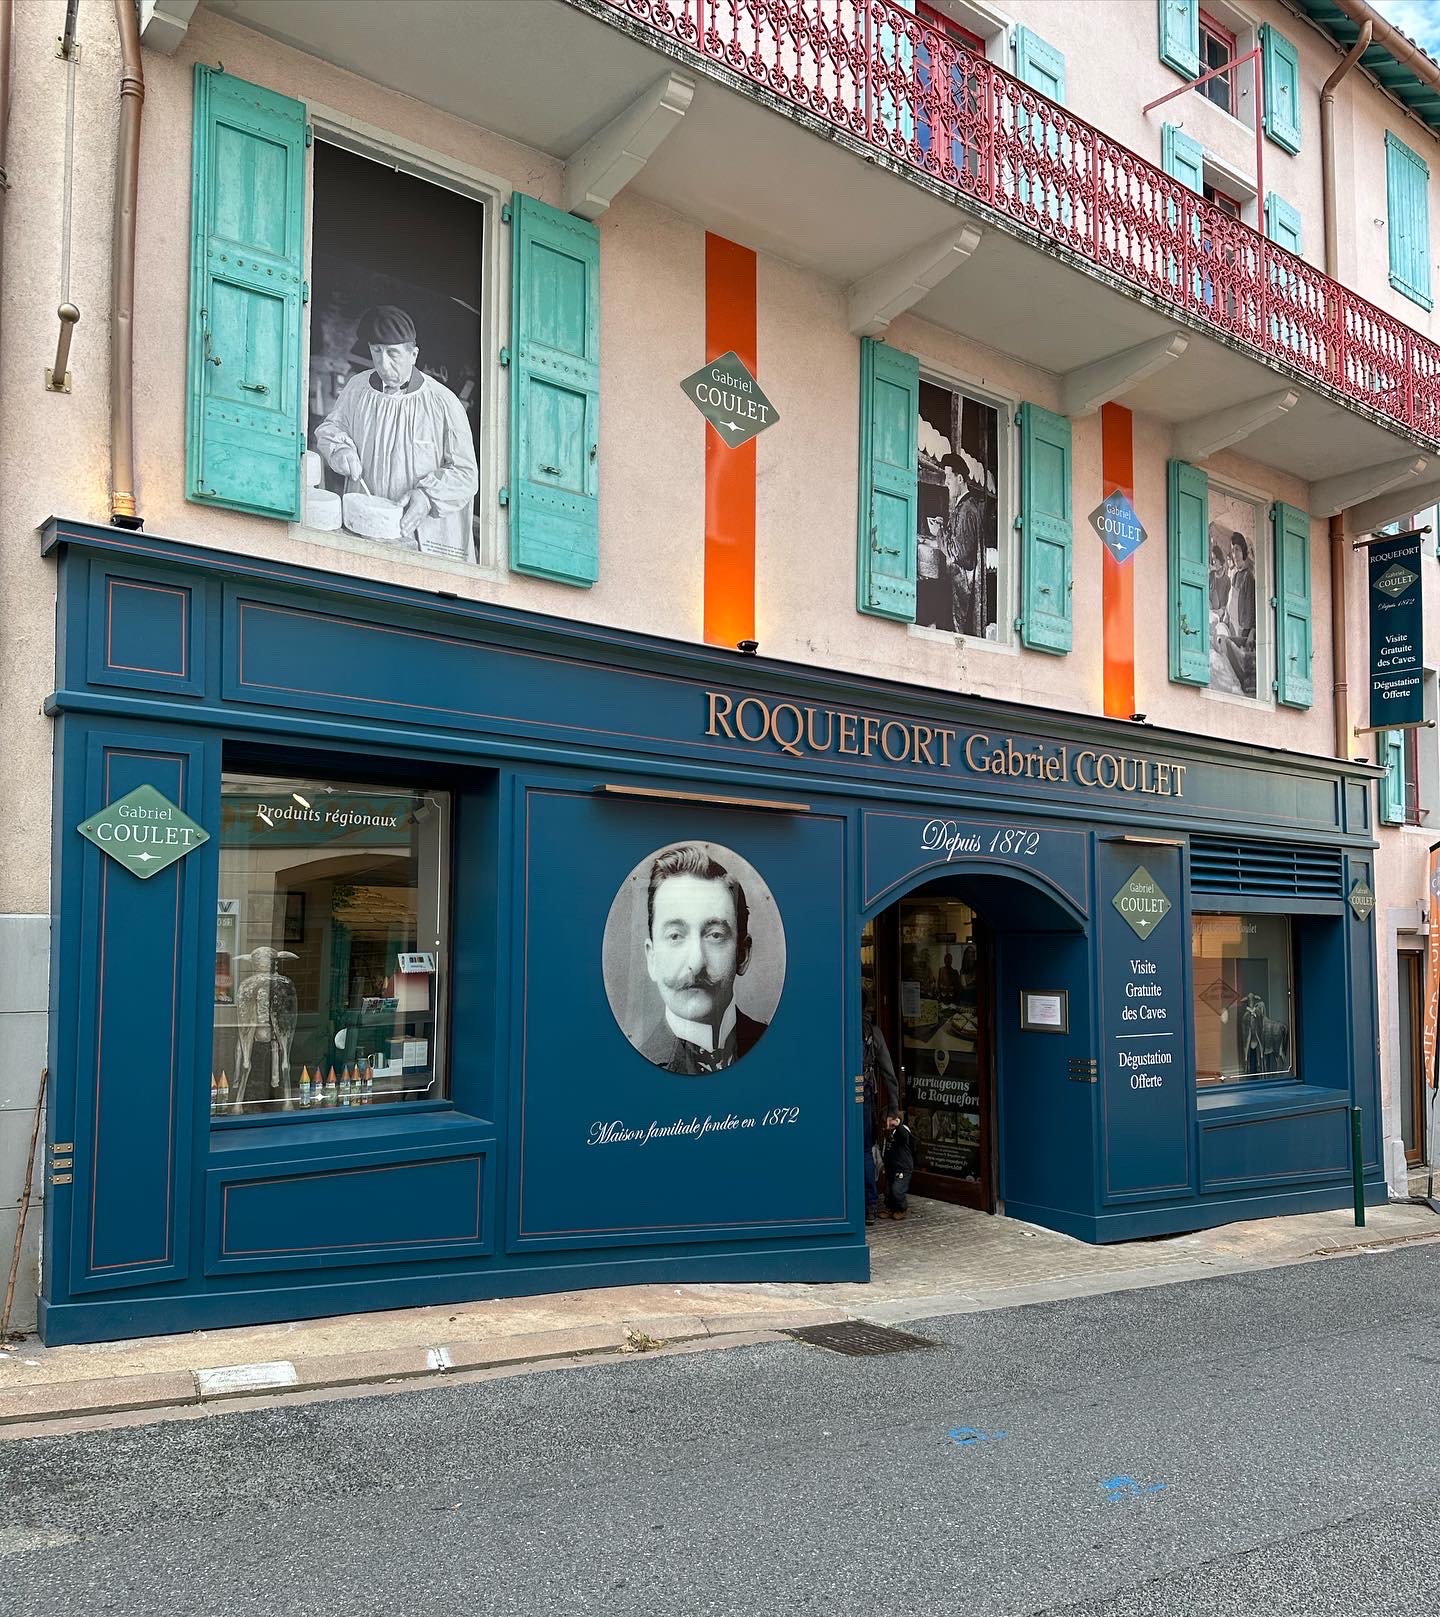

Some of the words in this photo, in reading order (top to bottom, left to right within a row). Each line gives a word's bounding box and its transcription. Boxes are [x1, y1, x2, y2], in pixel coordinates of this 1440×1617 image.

[711, 368, 753, 393] Gabriel
[696, 383, 769, 423] COULET
[1106, 503, 1131, 520] Gabriel
[1097, 516, 1141, 542] COULET
[1370, 546, 1419, 563] ROQUEFORT
[1379, 575, 1413, 588] COULET
[1385, 634, 1408, 643] Visite
[1381, 644, 1412, 655] Gratuite
[1377, 659, 1390, 667] des
[1392, 656, 1416, 665] Caves
[1374, 677, 1420, 690] Dégustation
[1382, 690, 1411, 699] Offerte
[704, 691, 956, 767] ROQUEFORT
[965, 734, 1069, 782] Gabriel
[1076, 751, 1187, 797] COULET
[118, 805, 172, 820] Gabriel
[257, 803, 321, 822] Produits
[325, 807, 397, 827] régionaux
[97, 823, 194, 845] COULET
[921, 819, 981, 861] Depuis
[989, 829, 1040, 855] 1872
[1130, 882, 1154, 893] Gabriel
[1121, 897, 1164, 912] COULET
[1351, 896, 1373, 905] COULET
[1130, 959, 1156, 974] Visite
[1125, 982, 1162, 997] Gratuite
[1122, 1006, 1137, 1020] des
[1140, 1005, 1166, 1019] Caves
[1119, 1050, 1172, 1070] Dégustation
[1130, 1074, 1162, 1090] Offerte
[917, 1088, 927, 1100] le
[587, 1120, 646, 1145] Maison
[640, 1117, 700, 1146] familiale
[694, 1114, 740, 1141] fondée
[741, 1118, 755, 1128] en
[761, 1107, 800, 1126] 1872
